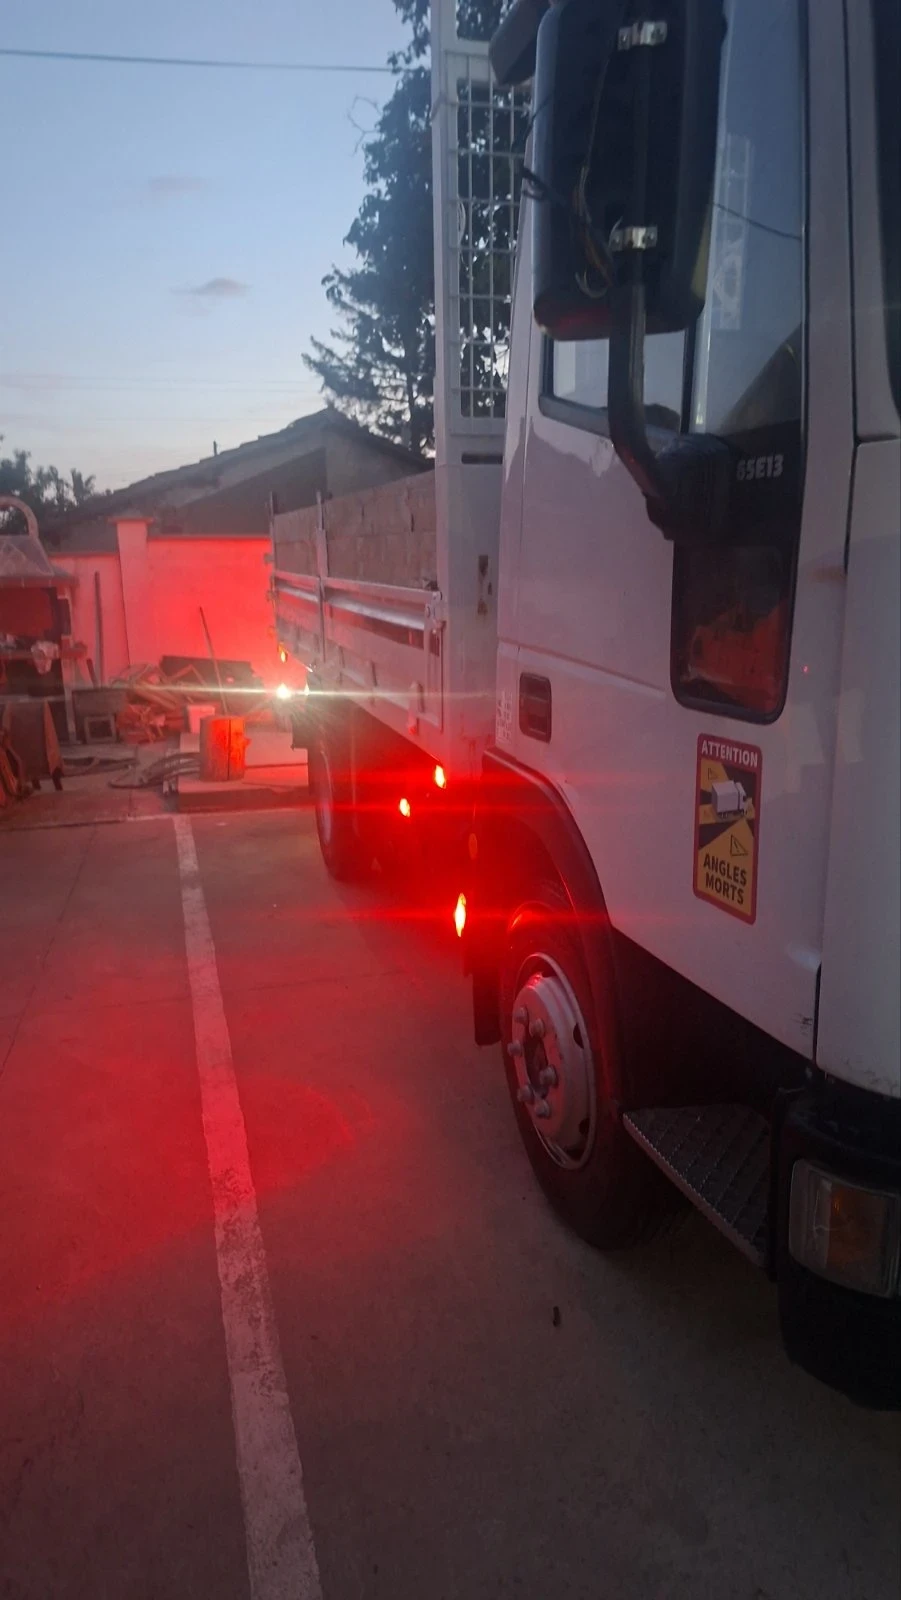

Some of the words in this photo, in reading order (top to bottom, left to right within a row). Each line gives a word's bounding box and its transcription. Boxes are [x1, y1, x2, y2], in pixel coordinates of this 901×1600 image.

[736, 455, 784, 480] 65E13
[701, 739, 758, 768] ATTENTION
[703, 853, 747, 885] ANGLES
[705, 872, 744, 906] MORTS
